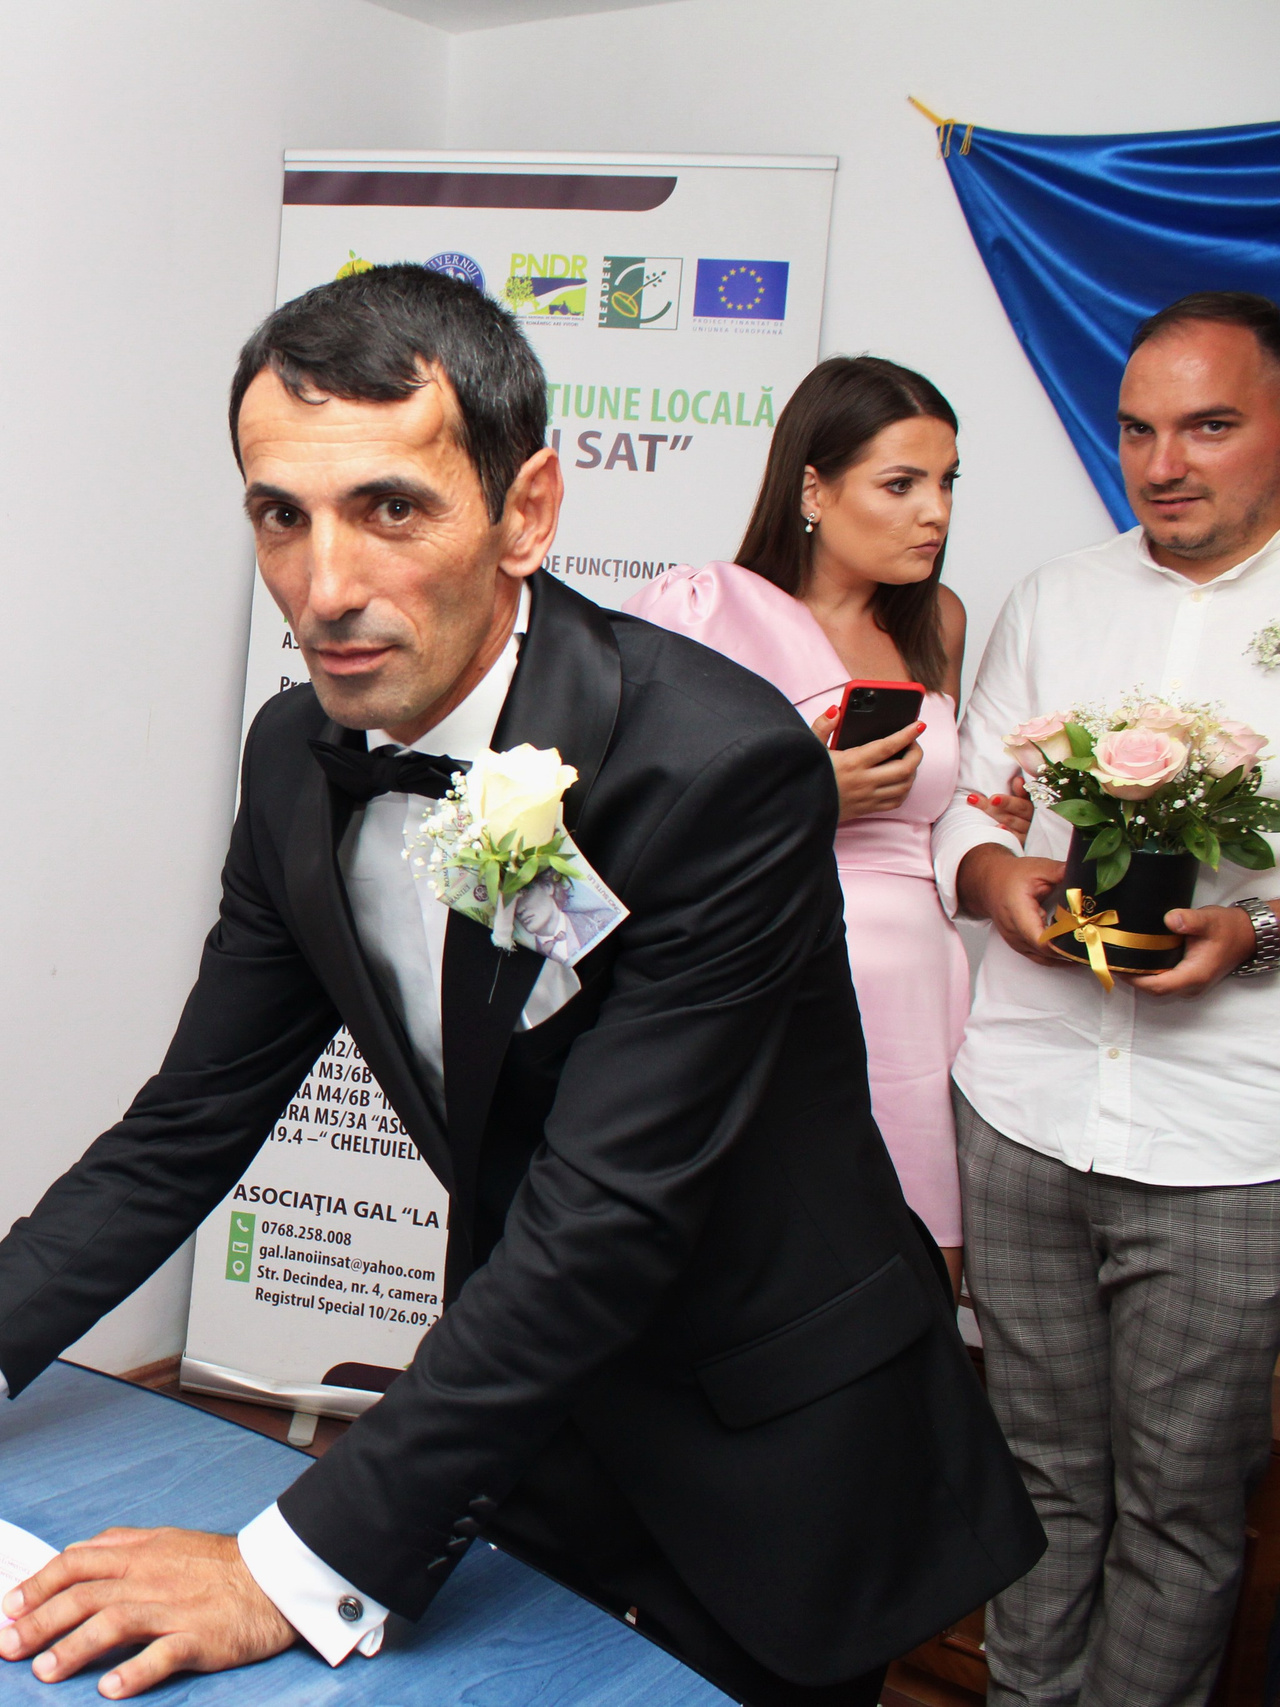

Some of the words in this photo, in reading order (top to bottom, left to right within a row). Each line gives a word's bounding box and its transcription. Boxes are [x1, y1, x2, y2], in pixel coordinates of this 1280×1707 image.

[424, 254, 480, 280] UVERNUL
[510, 253, 588, 279] PNDR
[598, 260, 612, 324] LEADER
[650, 385, 775, 427] LOCALĂ
[318, 1061, 373, 1084] M3/6B
[316, 1084, 370, 1107] M4/6B
[314, 1107, 367, 1131] M5/3A
[353, 1200, 398, 1223] GAL
[261, 1220, 352, 1246] 0768.258.008
[259, 1244, 436, 1282] gal.lanoiinsat@yahoo.com
[257, 1265, 280, 1281] Str.
[283, 1268, 348, 1294] Decindea,
[351, 1280, 369, 1295] nr.
[372, 1283, 385, 1299] 4,
[387, 1288, 438, 1305] camera
[255, 1287, 315, 1309] Registrul
[317, 1297, 365, 1317] Special
